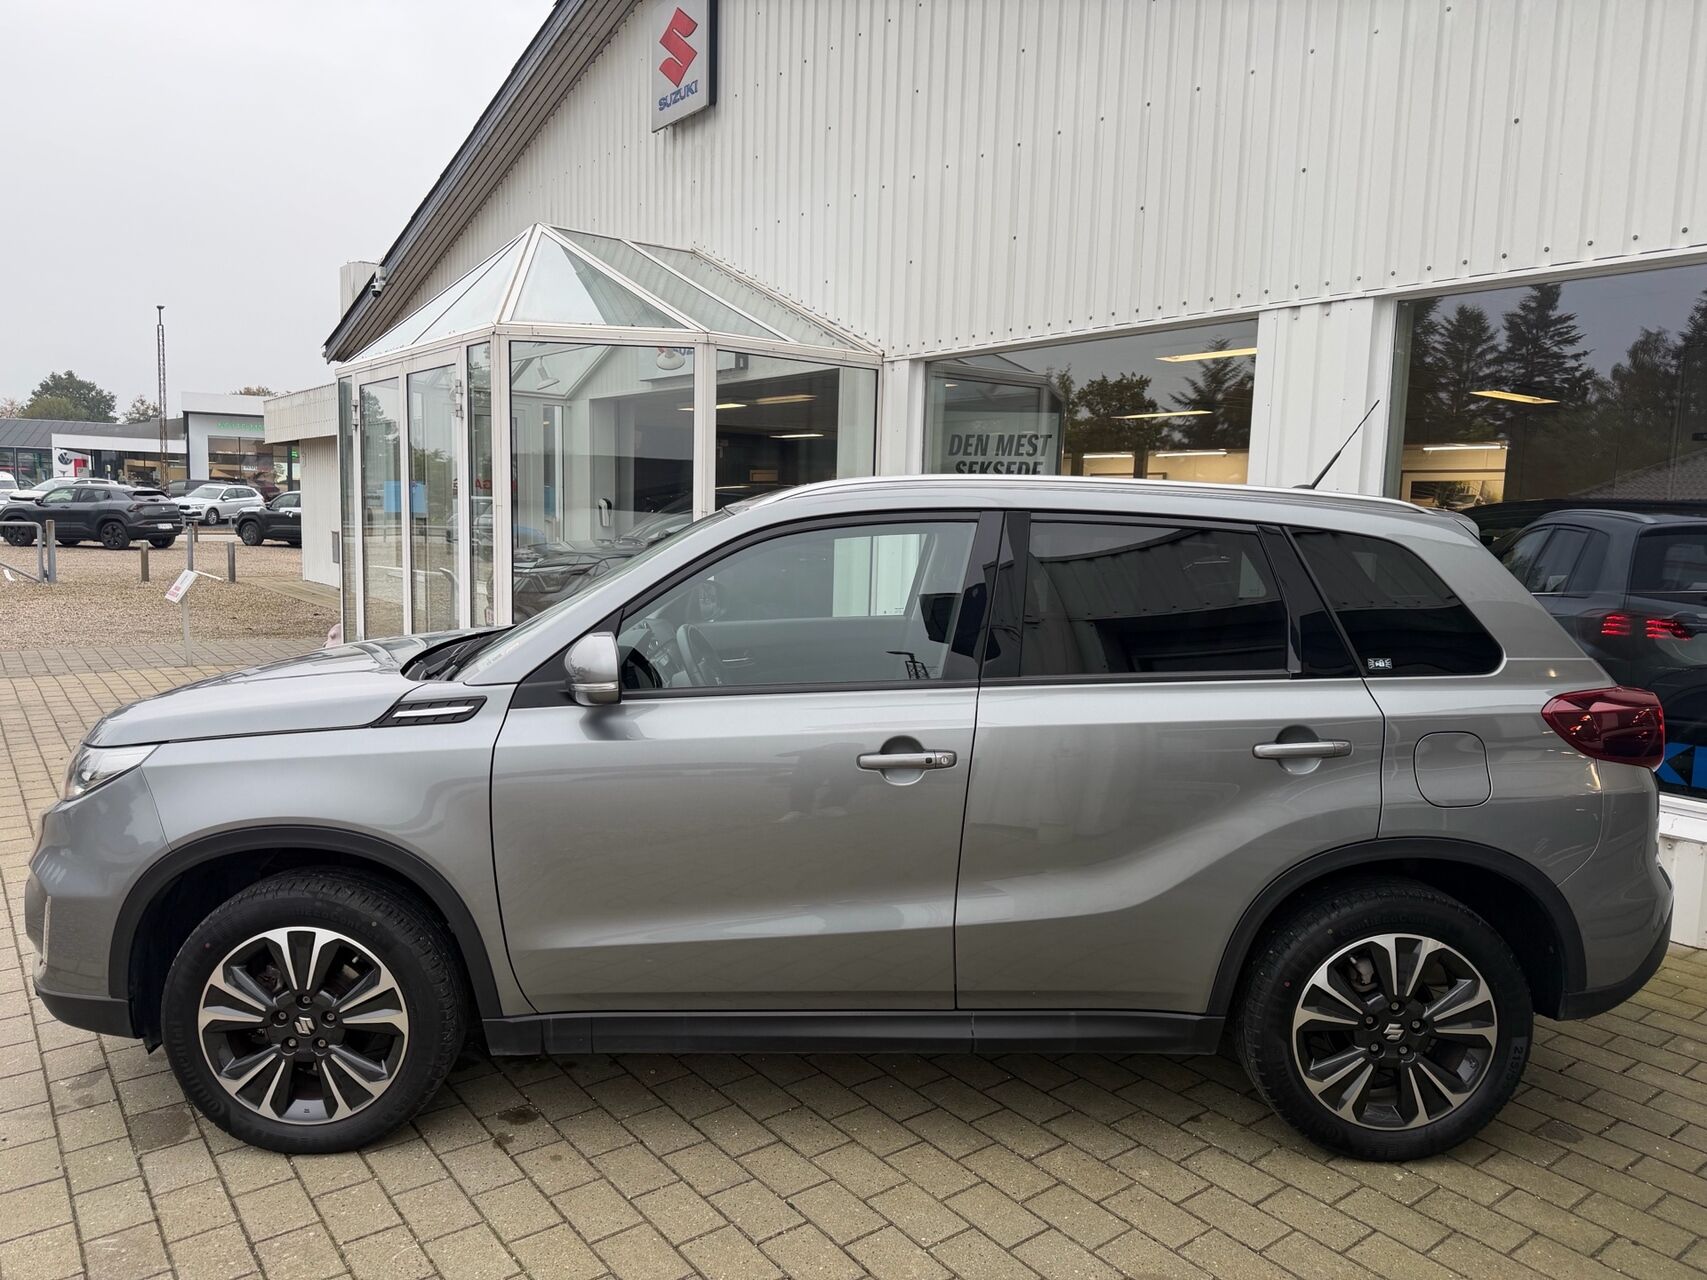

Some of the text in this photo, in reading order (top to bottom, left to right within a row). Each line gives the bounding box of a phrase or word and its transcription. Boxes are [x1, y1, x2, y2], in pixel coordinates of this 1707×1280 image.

[658, 79, 698, 111] SUZUKI
[948, 433, 1052, 458] DEN MEST
